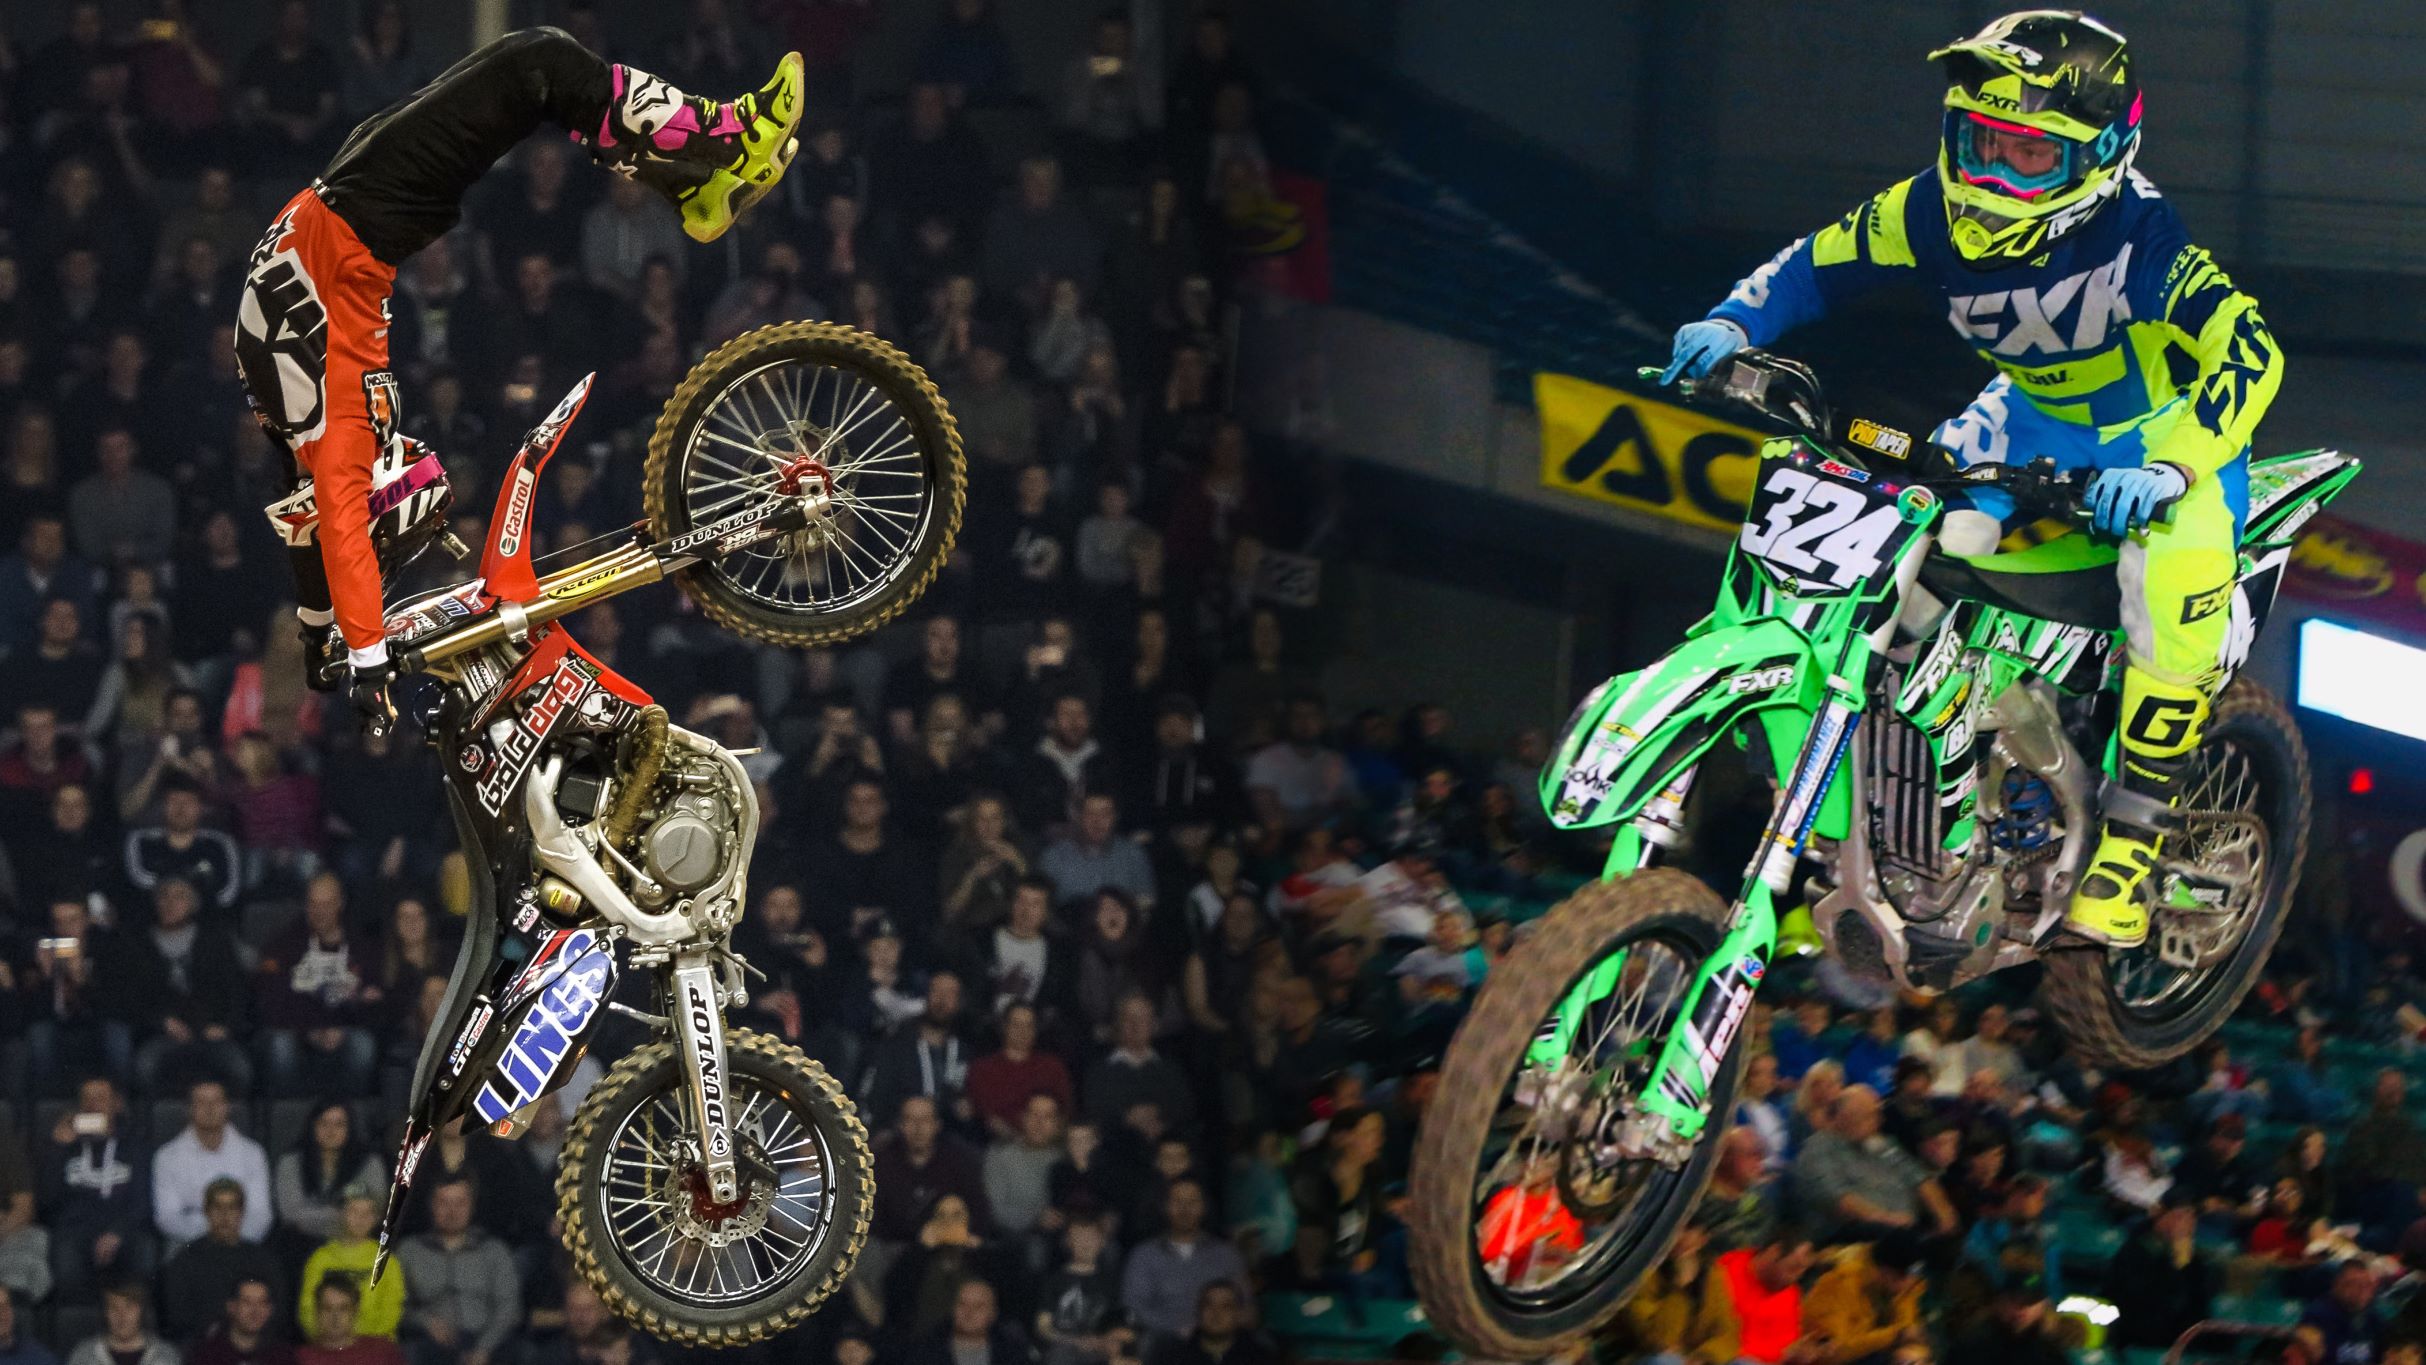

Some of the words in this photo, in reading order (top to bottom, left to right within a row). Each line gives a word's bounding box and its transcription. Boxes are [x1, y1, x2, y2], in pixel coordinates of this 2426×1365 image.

[1977, 92, 2020, 113] FXR
[1948, 242, 2132, 356] FXR
[1817, 459, 1871, 483] AMSOIL
[505, 477, 532, 539] Castrol
[672, 500, 783, 553] DUNLOP
[1741, 468, 1903, 589] 324
[1728, 666, 1794, 695] FXR
[1926, 631, 1963, 695] FXR
[2127, 695, 2197, 748] G
[687, 984, 725, 1128] DUNLOP
